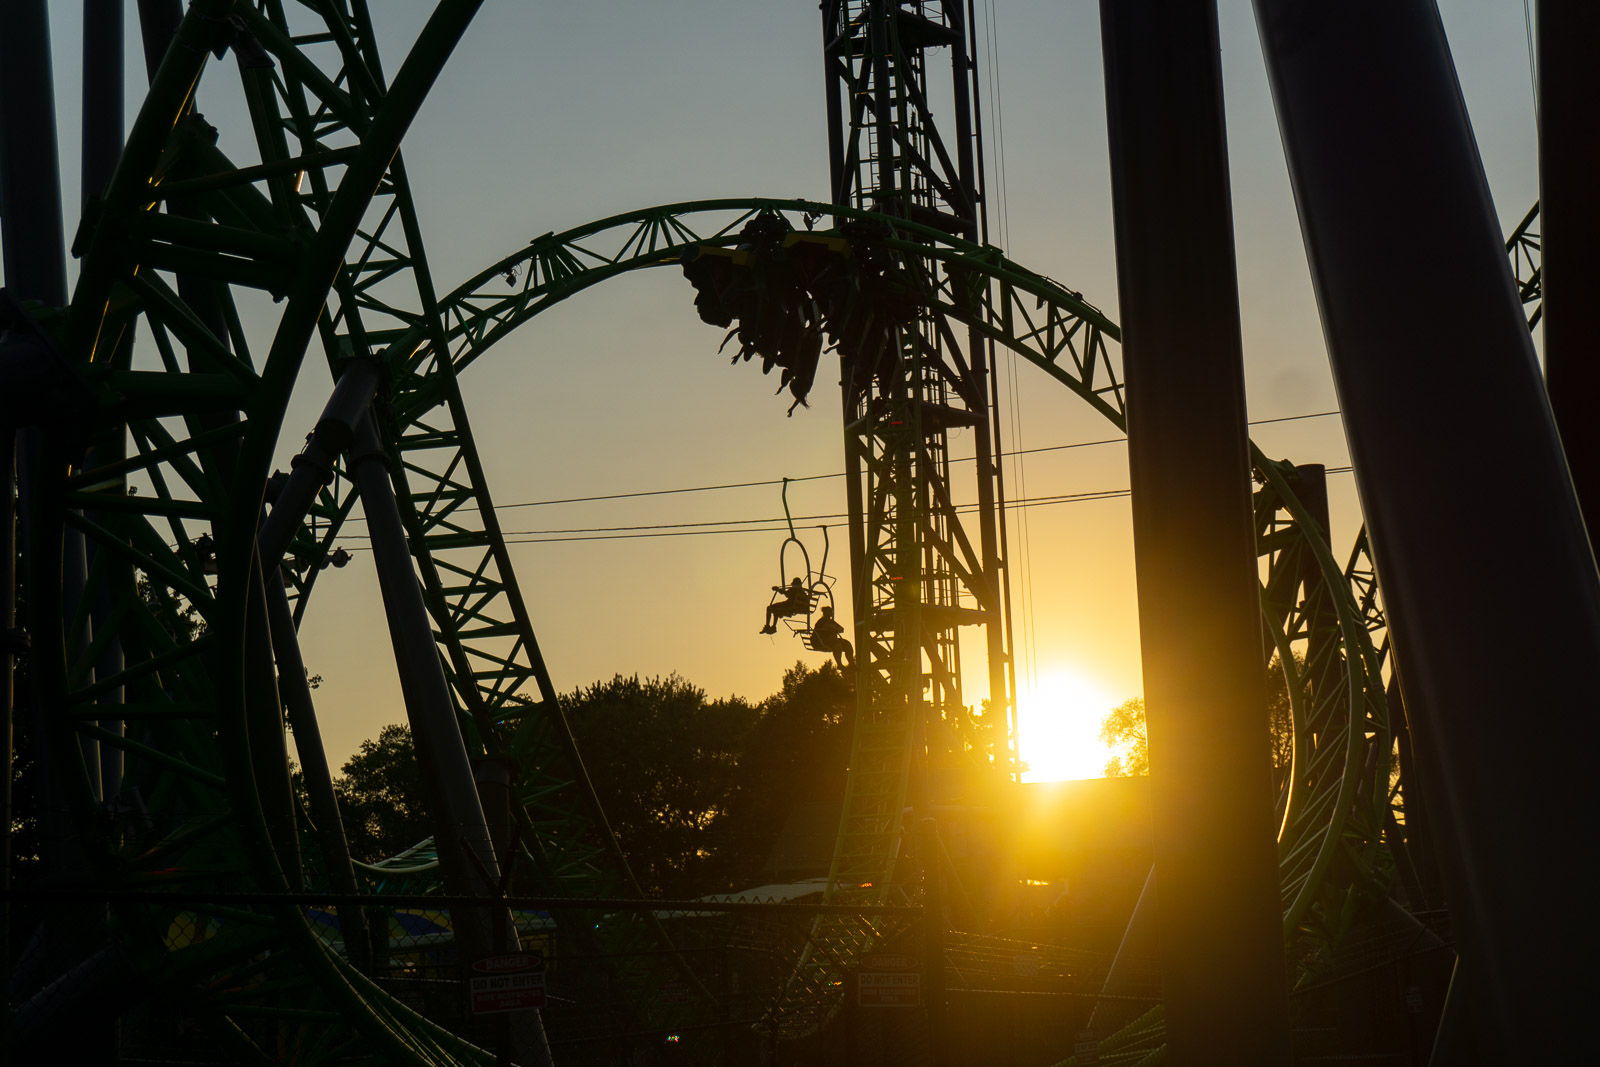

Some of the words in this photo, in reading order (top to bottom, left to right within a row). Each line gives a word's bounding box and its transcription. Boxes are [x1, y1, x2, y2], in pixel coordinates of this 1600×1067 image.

[486, 956, 528, 969] DANGER
[872, 957, 907, 967] DANGER
[473, 979, 487, 990] DO
[490, 977, 509, 989] NOT
[512, 975, 543, 986] ENTER
[861, 975, 872, 984] DO
[874, 975, 889, 984] NOT
[892, 975, 918, 984] ENTER
